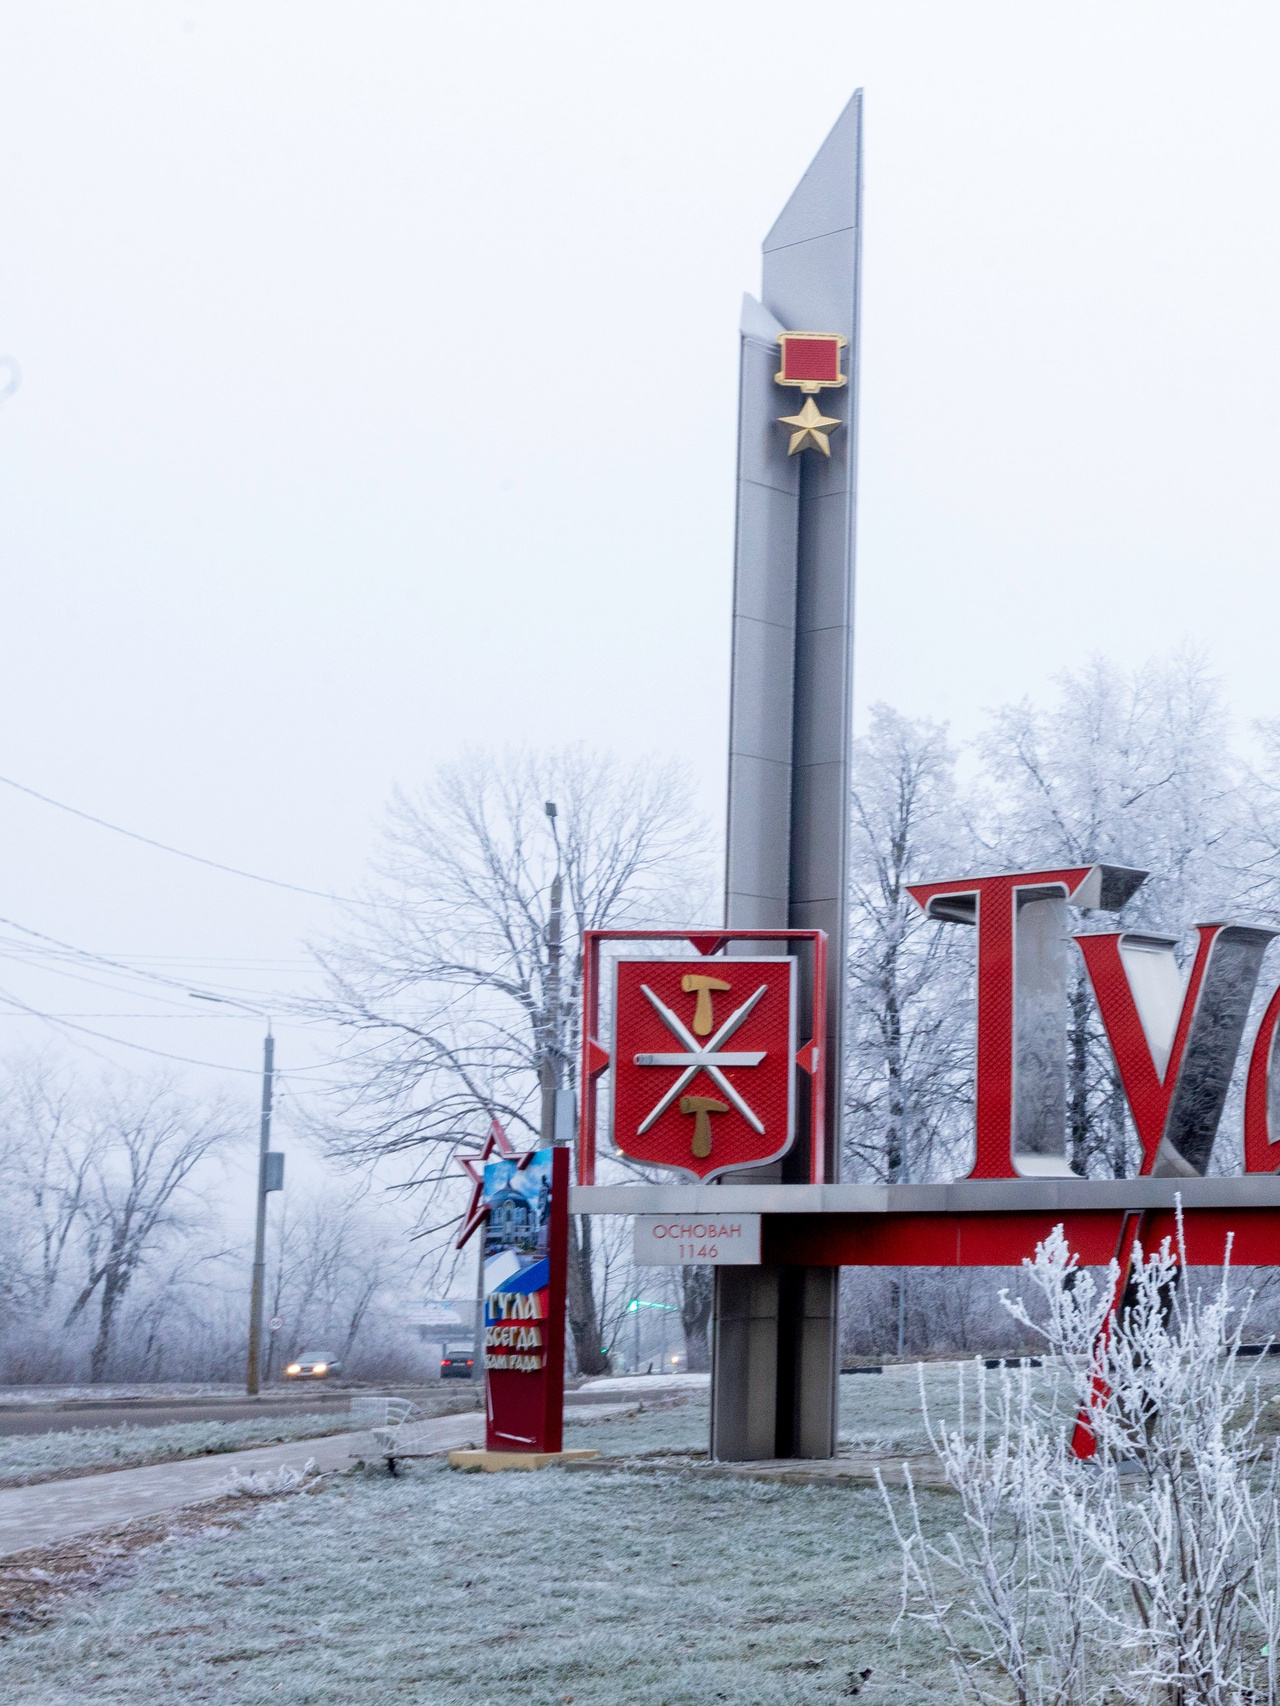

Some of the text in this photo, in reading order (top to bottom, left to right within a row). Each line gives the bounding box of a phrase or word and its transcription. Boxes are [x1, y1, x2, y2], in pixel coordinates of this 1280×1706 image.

[652, 1224, 742, 1239] ОСНОВАН
[679, 1244, 719, 1258] 1146
[488, 1292, 543, 1320] ТУЛА
[485, 1326, 542, 1351] ВСЕГДА
